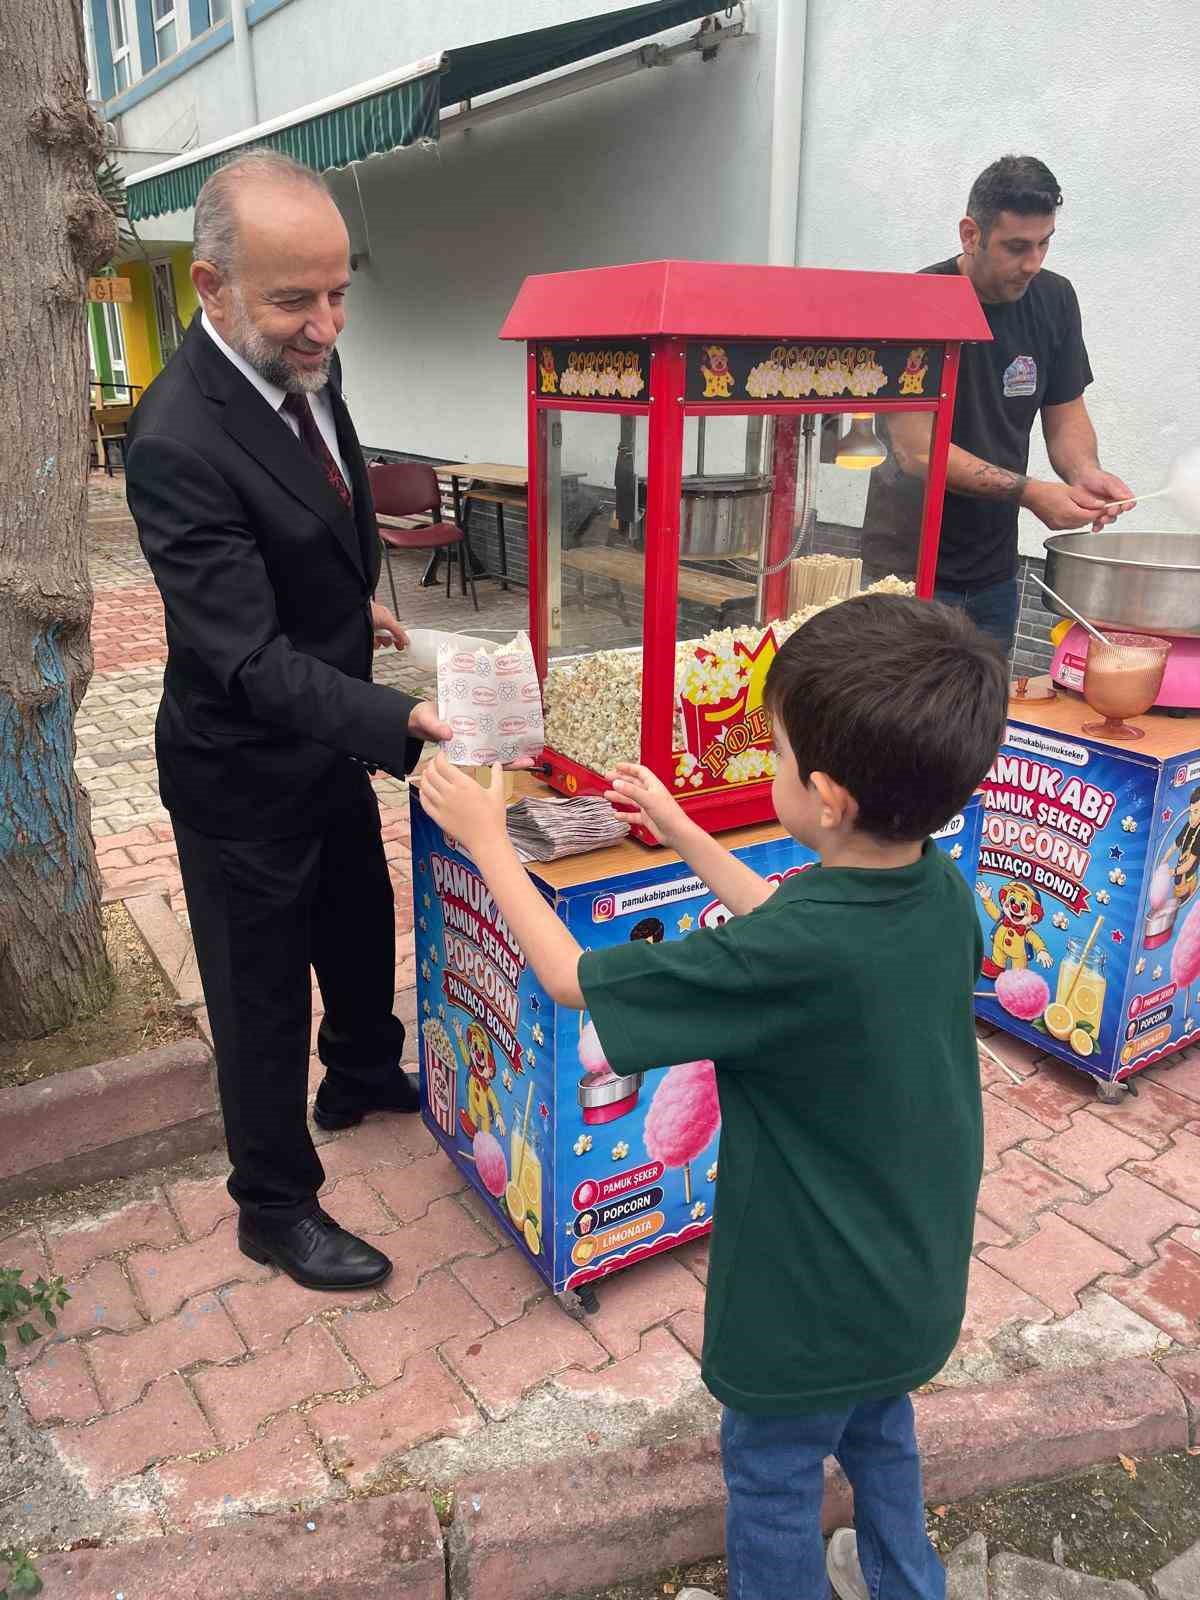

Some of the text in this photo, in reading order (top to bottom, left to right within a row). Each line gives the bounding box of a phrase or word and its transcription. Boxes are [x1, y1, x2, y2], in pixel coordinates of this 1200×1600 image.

[984, 756, 1114, 826] AMUK ABİ
[984, 789, 1092, 842] AMUK ŞEKER
[982, 815, 1085, 877] OPCORN
[431, 856, 495, 924] PAMUK
[1034, 866, 1081, 903] BONDİ
[443, 900, 481, 944] PAMUK
[444, 932, 520, 1029] POPCORN
[447, 976, 517, 1058] PALYAÇO BONDİ
[603, 1166, 659, 1195] PAMUK ŞEKER
[603, 1194, 651, 1223] POPCORN
[603, 1221, 651, 1247] LİMONATA
